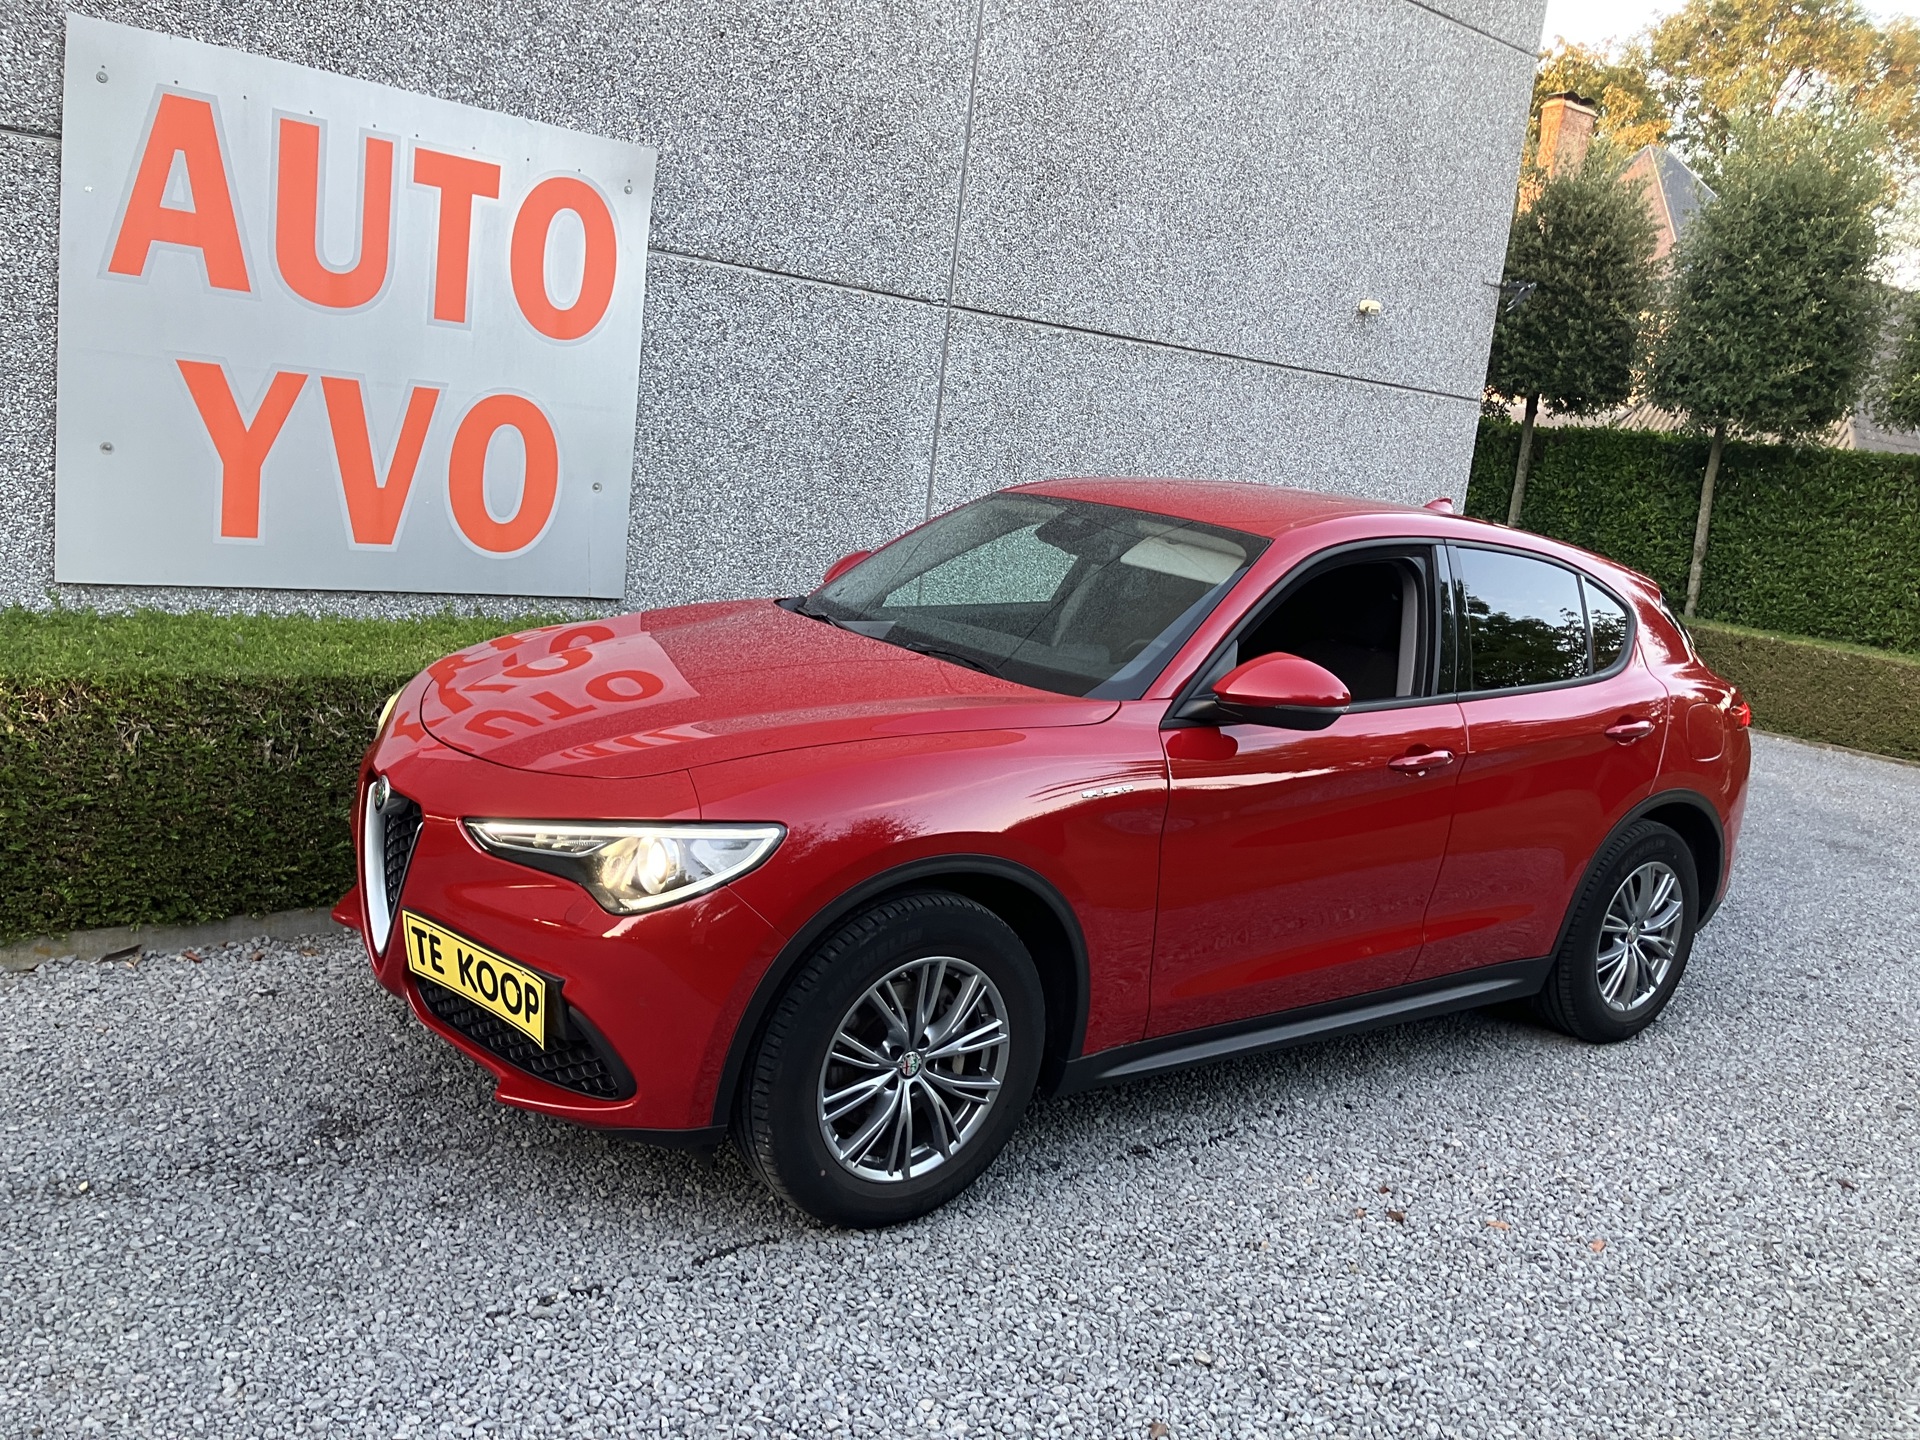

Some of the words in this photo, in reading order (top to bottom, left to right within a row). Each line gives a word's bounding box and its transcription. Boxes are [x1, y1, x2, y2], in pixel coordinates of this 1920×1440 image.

[109, 93, 617, 341] AUTO
[175, 359, 559, 554] YVO
[410, 925, 446, 975] TE
[456, 947, 540, 1024] KOOP
